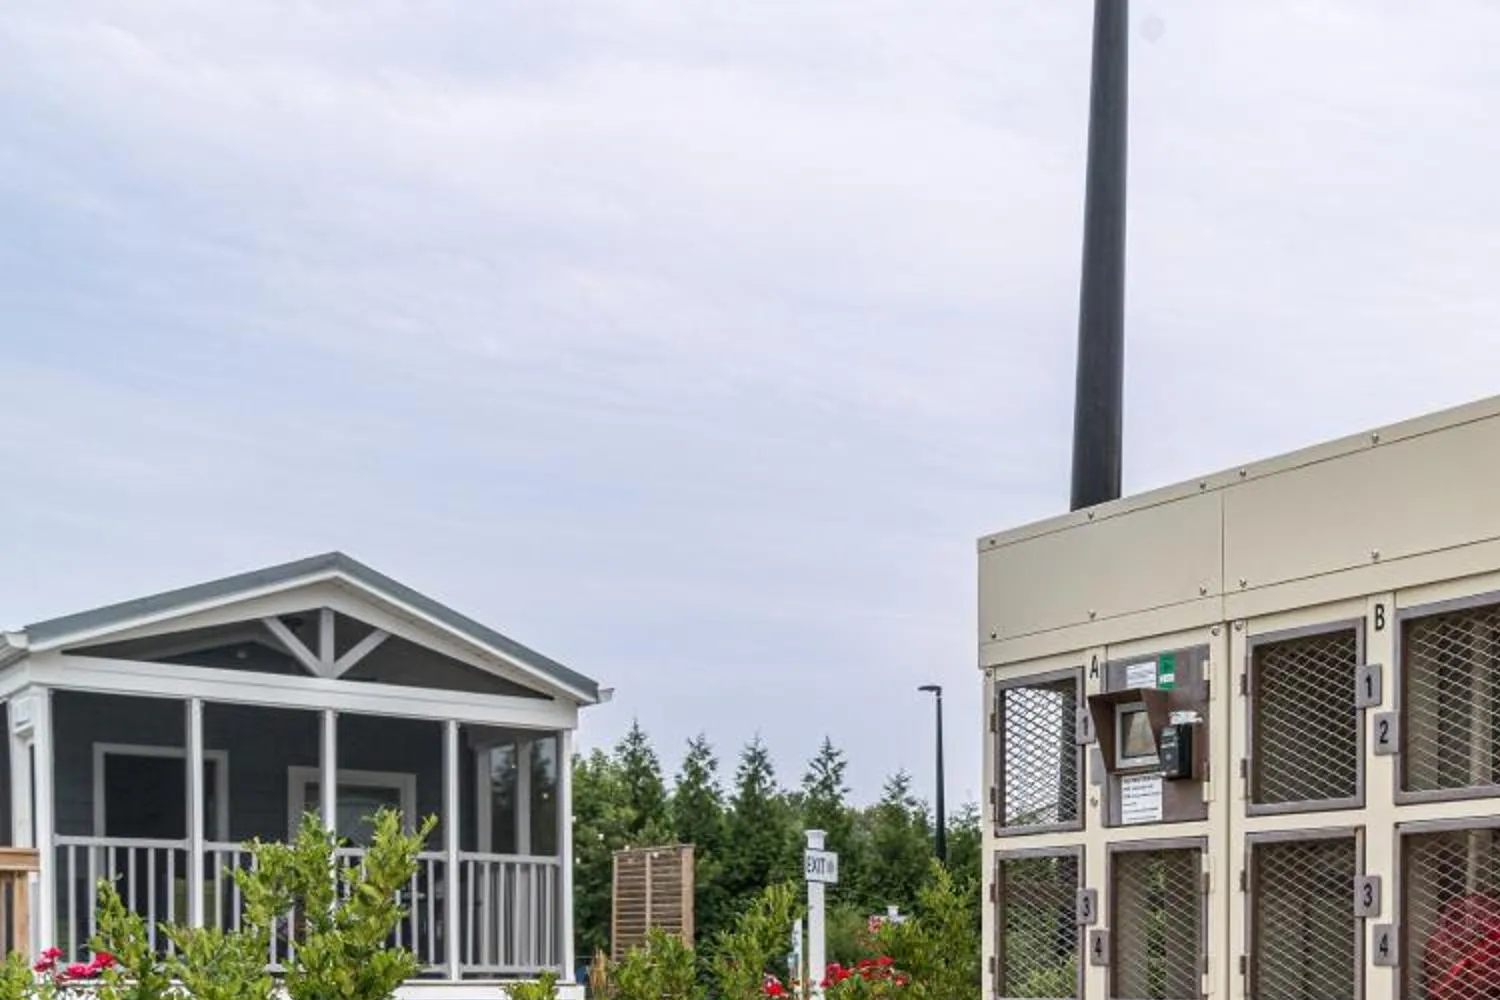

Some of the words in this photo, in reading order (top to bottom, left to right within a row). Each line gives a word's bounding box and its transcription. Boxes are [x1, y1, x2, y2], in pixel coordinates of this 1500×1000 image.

[1375, 604, 1385, 630] B
[1090, 655, 1098, 679] A
[1366, 674, 1373, 698] 1
[1083, 716, 1088, 737] 1
[1379, 720, 1388, 744] 2
[807, 856, 825, 875] EXIT
[1084, 896, 1090, 916] 3
[1364, 883, 1372, 907] 3
[1095, 936, 1102, 957] 4
[1379, 933, 1388, 957] 4
